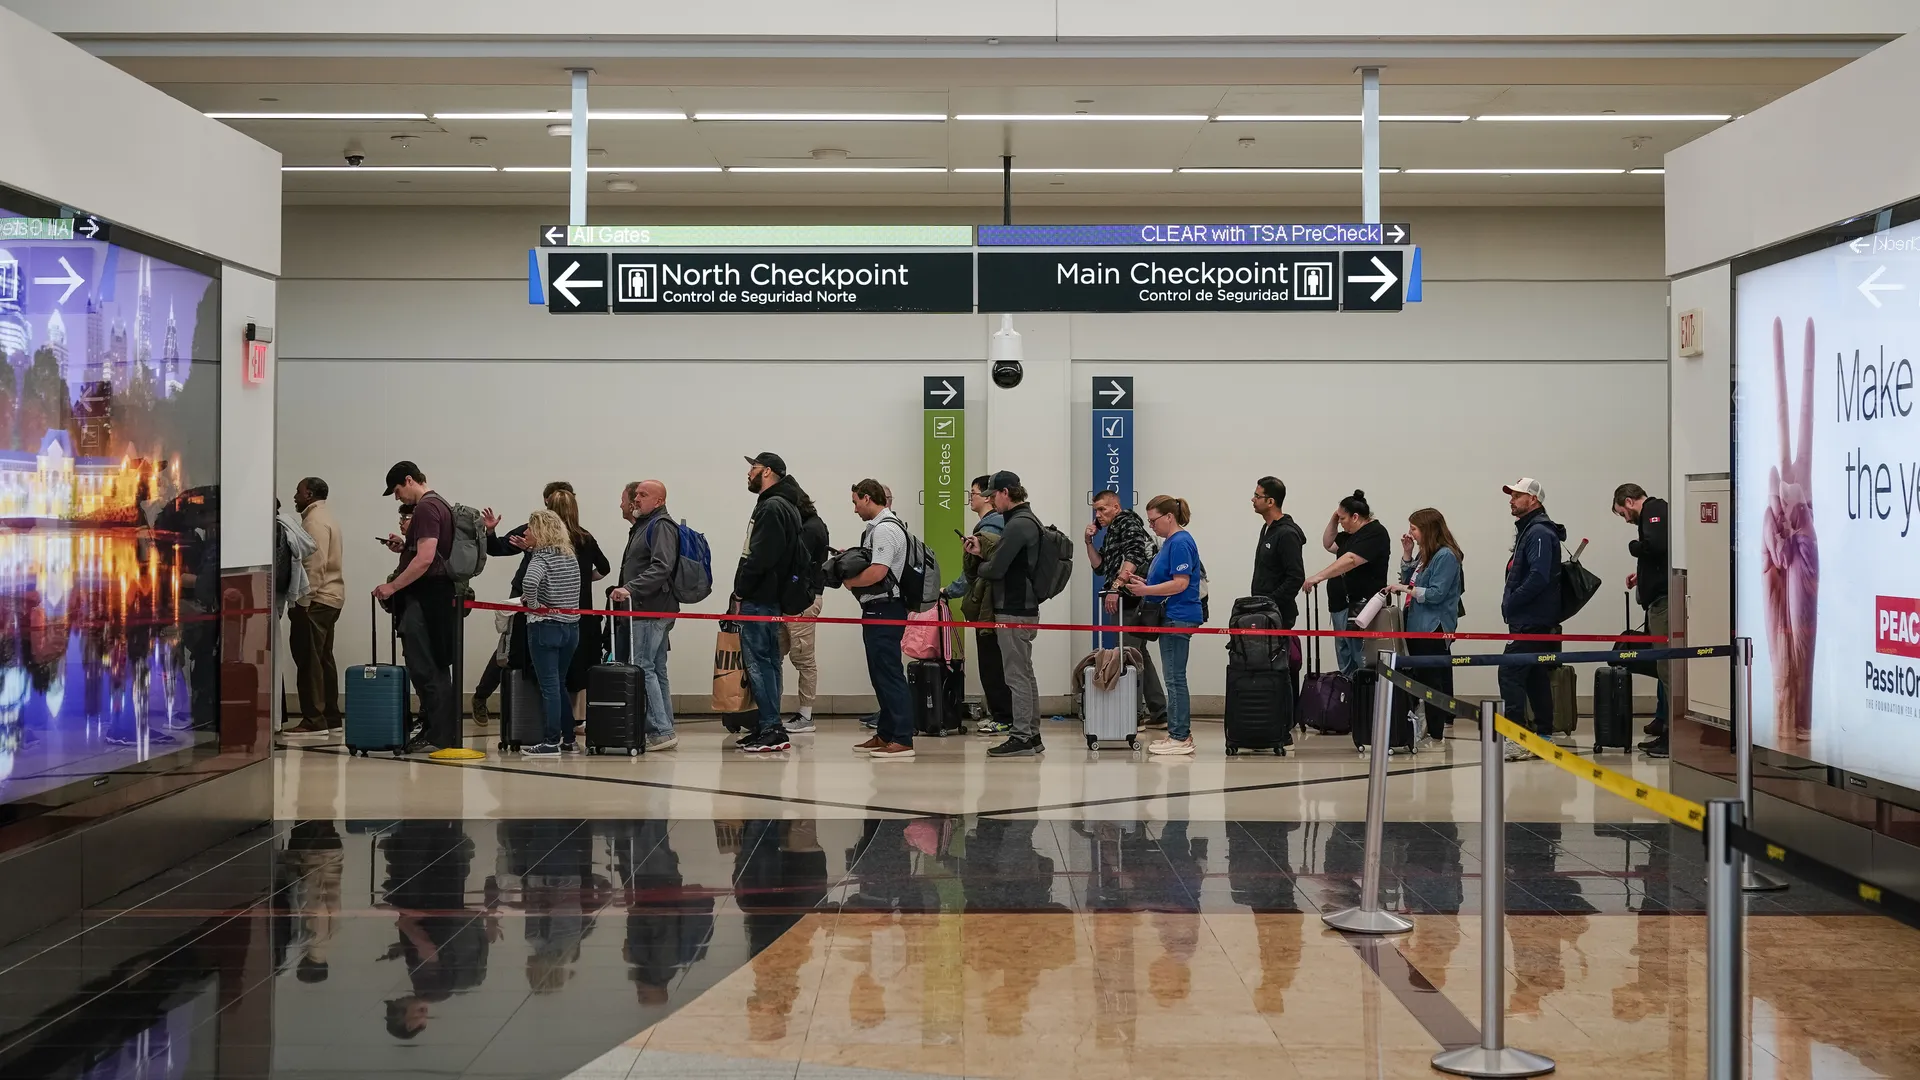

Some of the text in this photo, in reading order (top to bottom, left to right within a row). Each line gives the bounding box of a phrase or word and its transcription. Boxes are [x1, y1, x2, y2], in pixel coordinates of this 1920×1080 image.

[572, 226, 650, 243] All Gates
[1141, 225, 1379, 242] CLEAR with TSA PreCheck
[662, 262, 909, 290] North Checkpoint
[1057, 261, 1289, 289] Main Checkpoint
[662, 290, 857, 305] Control de Seguridad Norte
[1138, 288, 1289, 303] Control de Seguridad
[1681, 313, 1693, 349] EXIT
[1837, 345, 1913, 423] Make
[939, 443, 951, 510] All Gates
[1845, 447, 1920, 538] the y
[715, 650, 745, 670] NIK
[1538, 654, 1557, 663] spirit
[1620, 651, 1638, 660] spirit
[1697, 647, 1714, 656] spirit
[1452, 656, 1471, 665] spirit
[1865, 699, 1874, 710] THE
[1875, 701, 1904, 716] FOUNDATION
